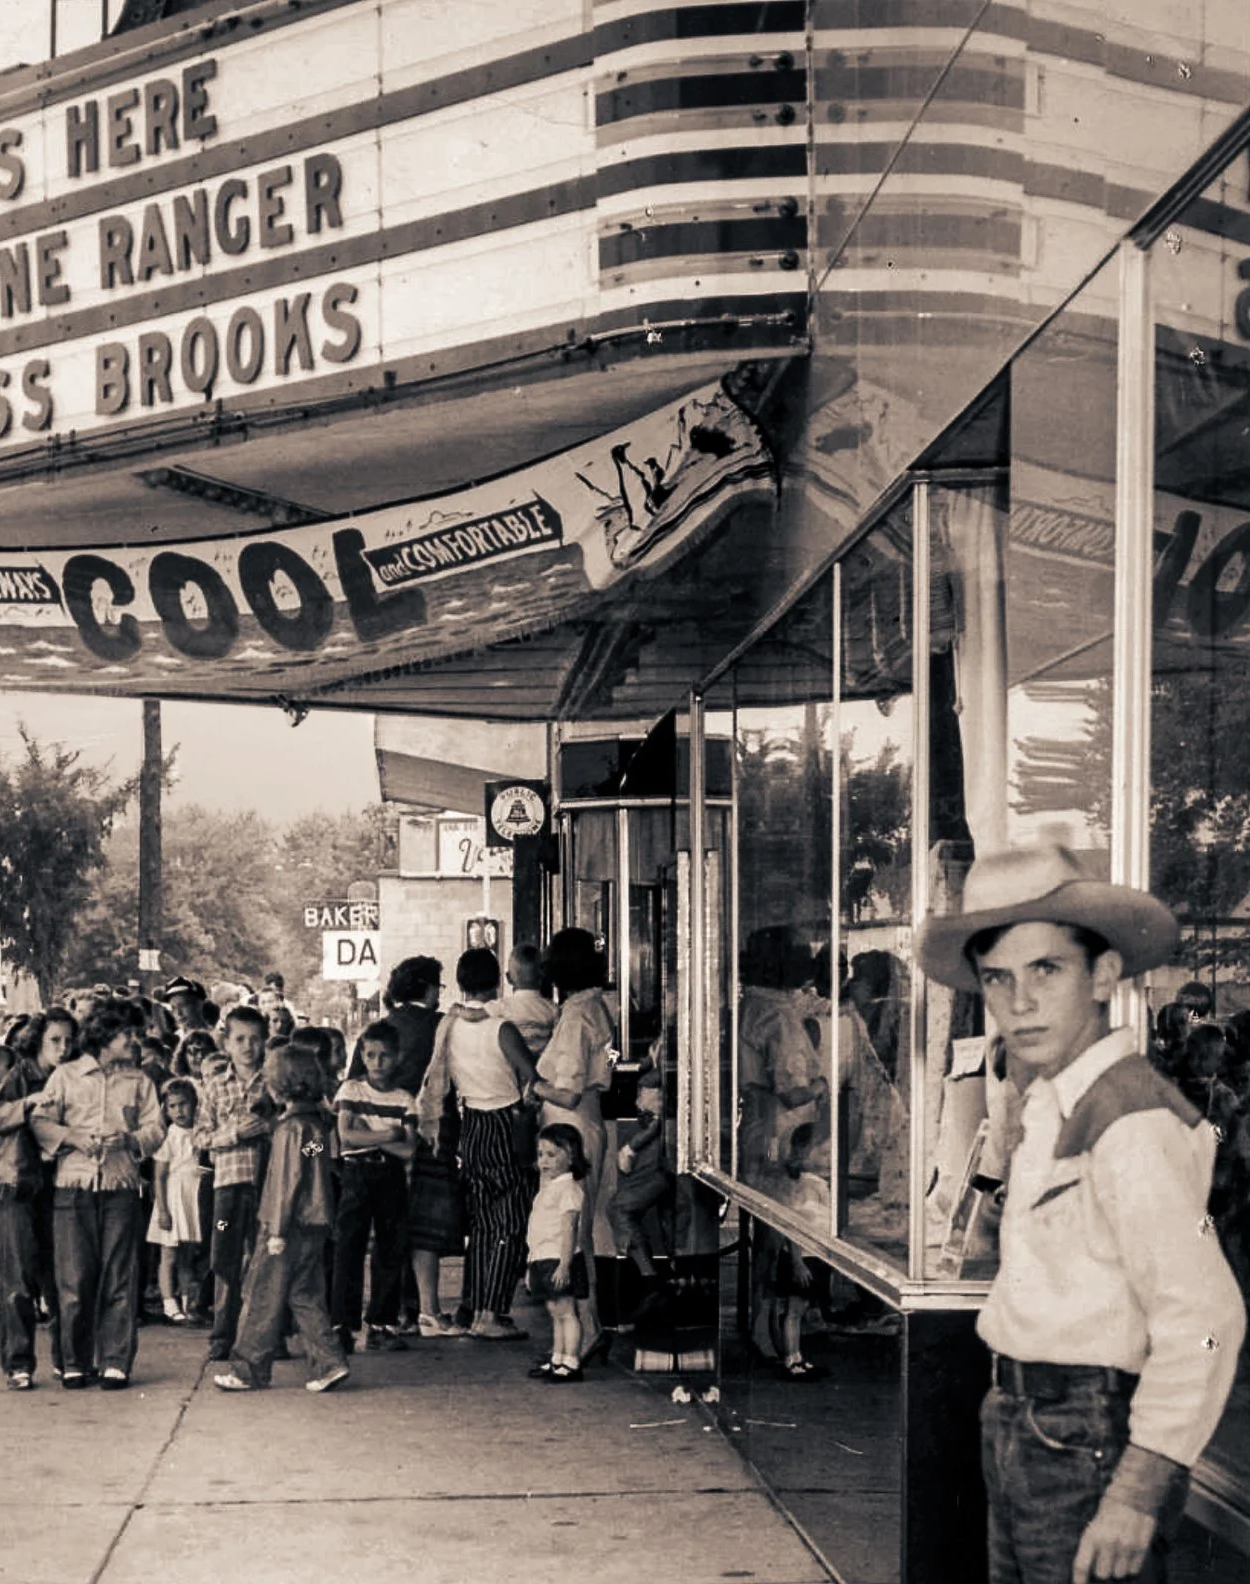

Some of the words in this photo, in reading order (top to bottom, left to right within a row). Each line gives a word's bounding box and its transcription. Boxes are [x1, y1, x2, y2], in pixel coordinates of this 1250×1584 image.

[66, 58, 218, 178] HERE
[98, 152, 343, 290] RANGER
[95, 282, 363, 416] BROOKS
[62, 527, 428, 662] COOL
